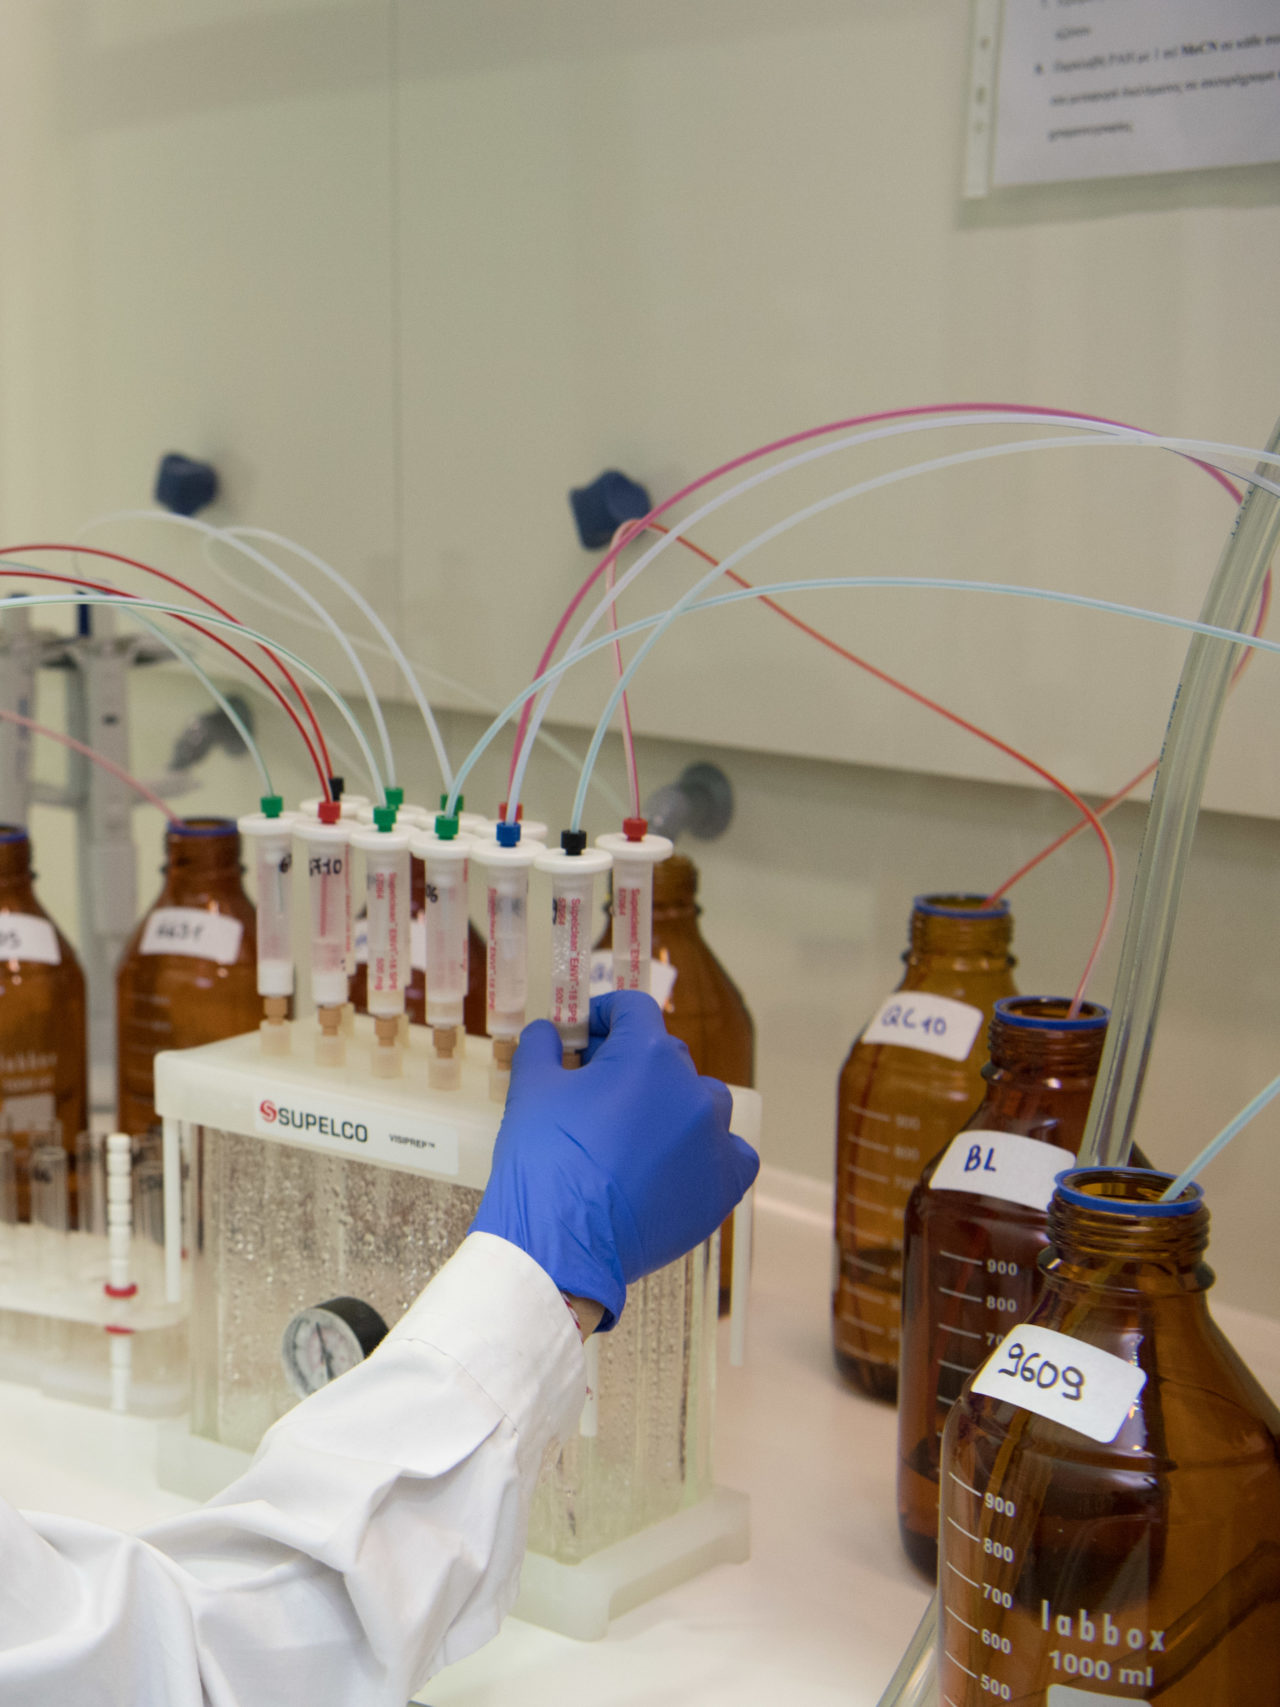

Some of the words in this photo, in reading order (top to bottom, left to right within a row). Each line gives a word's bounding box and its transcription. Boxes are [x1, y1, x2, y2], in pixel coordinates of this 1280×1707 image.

[567, 1002, 578, 1023] SPE
[278, 1107, 369, 1143] SUPELCO
[964, 1144, 997, 1172] BL
[987, 1260, 1018, 1276] 900
[986, 1297, 1017, 1313] 800
[986, 1332, 1004, 1347] 70
[998, 1342, 1086, 1402] 9609
[984, 1492, 1016, 1517] 900
[983, 1537, 1014, 1563] 800
[982, 1582, 1013, 1609] 700
[1041, 1599, 1166, 1651] labbox
[981, 1628, 1012, 1655] 600
[1049, 1649, 1111, 1681] 1000
[1119, 1666, 1154, 1687] ml
[980, 1673, 1011, 1700] 500
